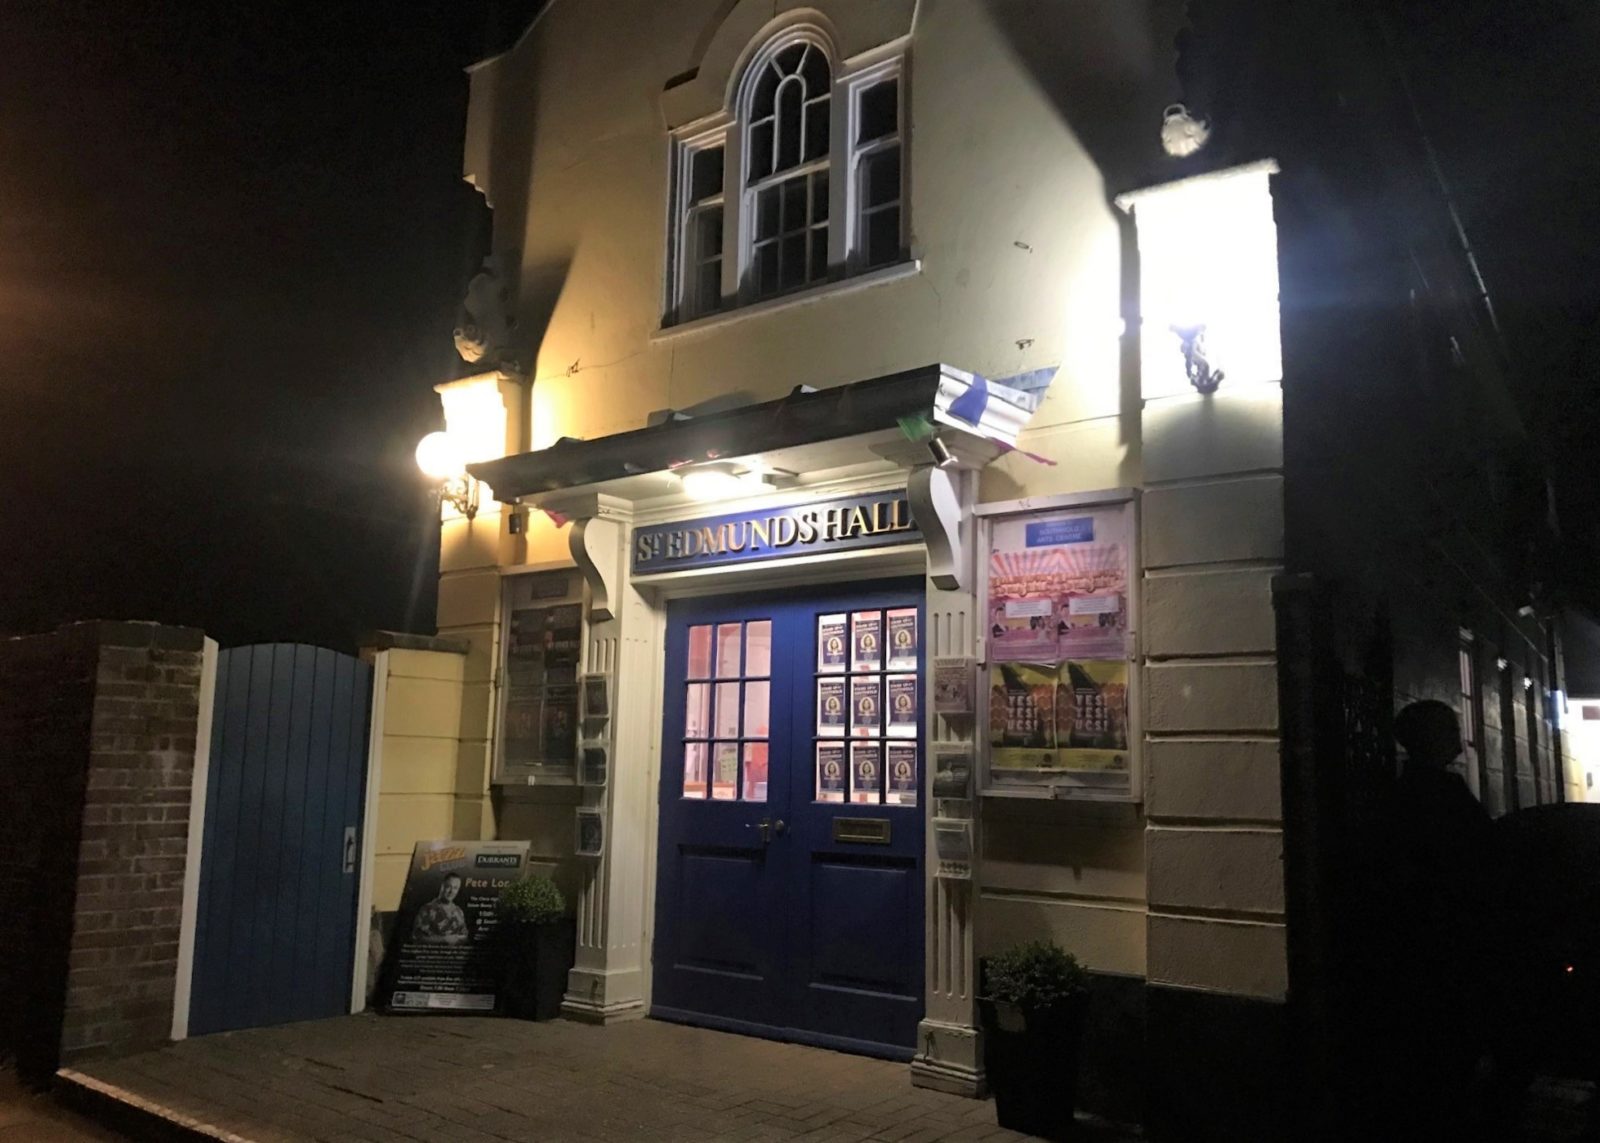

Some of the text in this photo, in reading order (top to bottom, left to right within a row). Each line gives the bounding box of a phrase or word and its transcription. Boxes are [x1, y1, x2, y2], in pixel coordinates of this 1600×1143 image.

[822, 499, 914, 542] HALL
[1008, 695, 1038, 706] YES!
[1076, 695, 1108, 706] YES!
[1008, 707, 1038, 718] YES!
[1076, 707, 1108, 719] YES!
[1008, 719, 1038, 730] UCS!
[1075, 719, 1108, 731] UCS!
[465, 877, 489, 888] Pete
